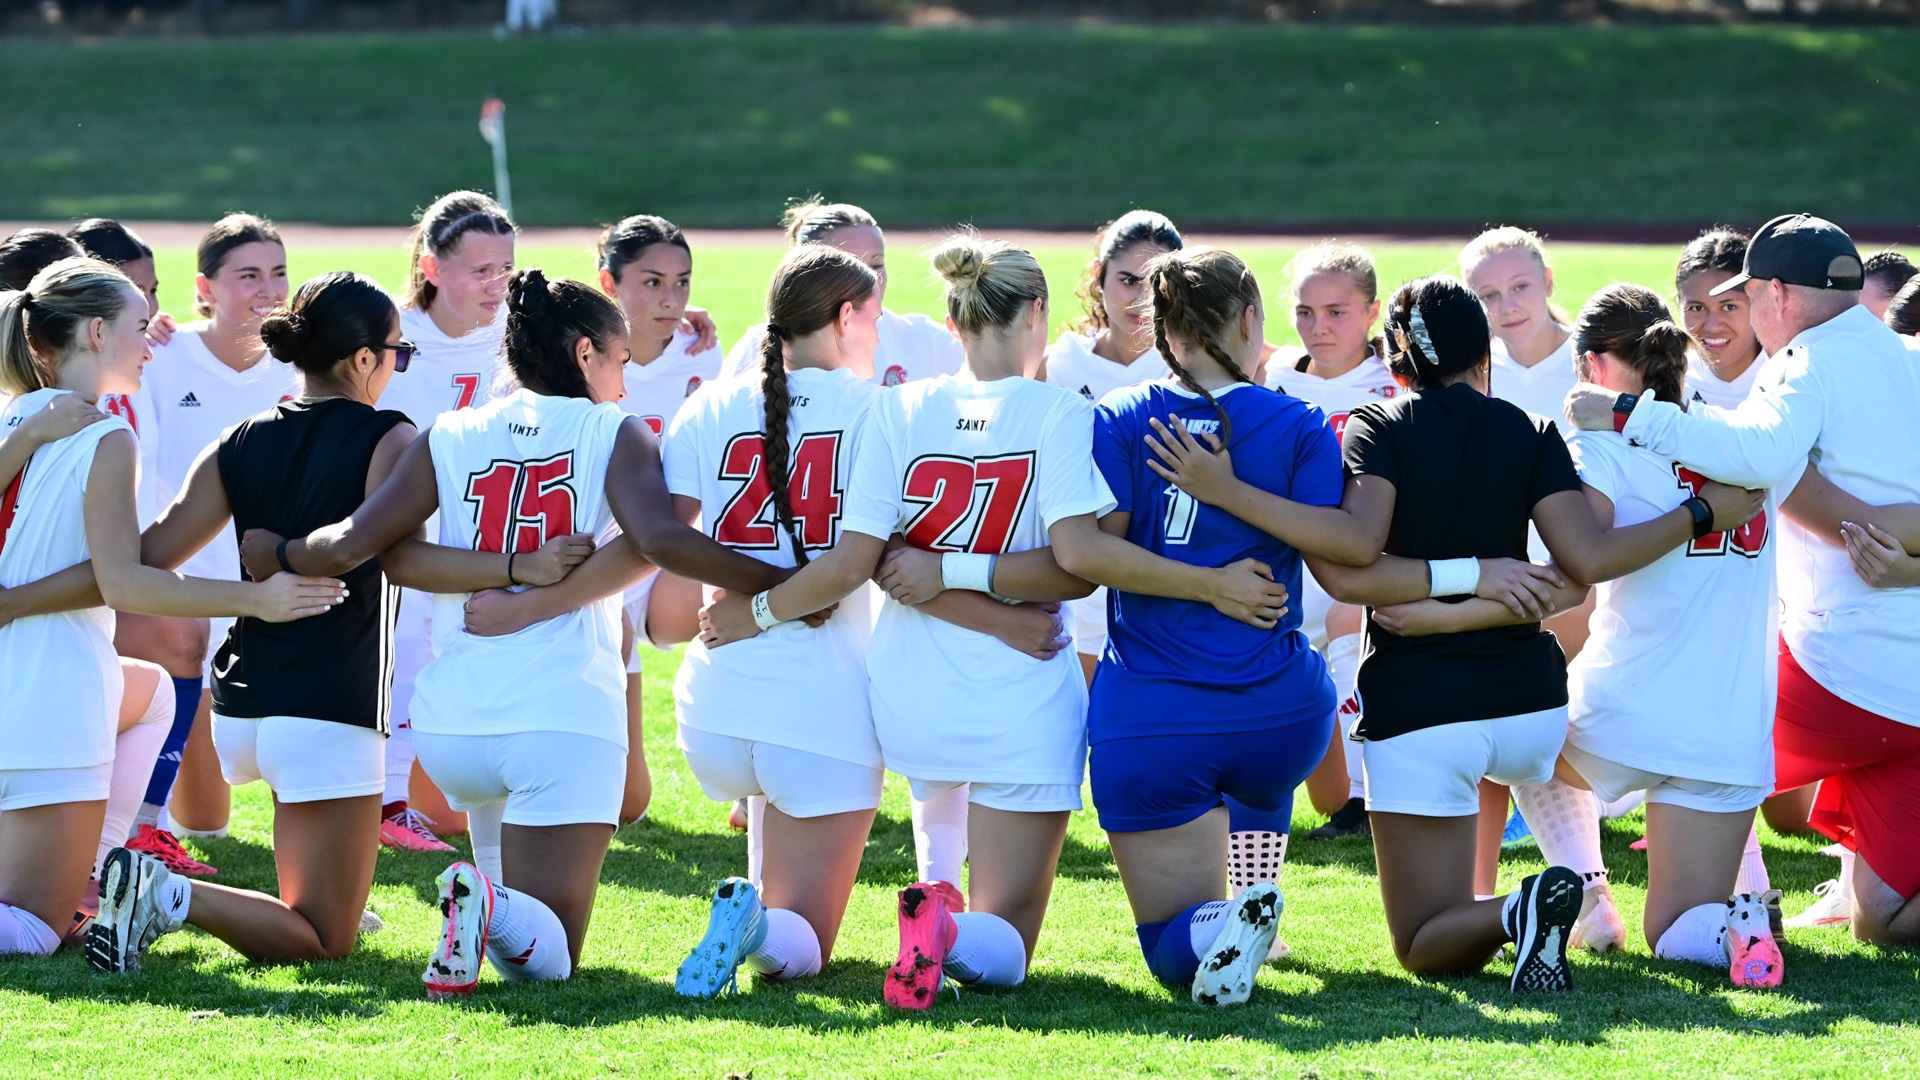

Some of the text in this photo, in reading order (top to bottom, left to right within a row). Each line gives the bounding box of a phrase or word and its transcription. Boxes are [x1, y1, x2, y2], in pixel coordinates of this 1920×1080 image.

[451, 372, 481, 411] 7
[463, 449, 577, 553] 15
[714, 430, 844, 552] 24
[902, 450, 1036, 553] 27
[1163, 483, 1199, 545] 1
